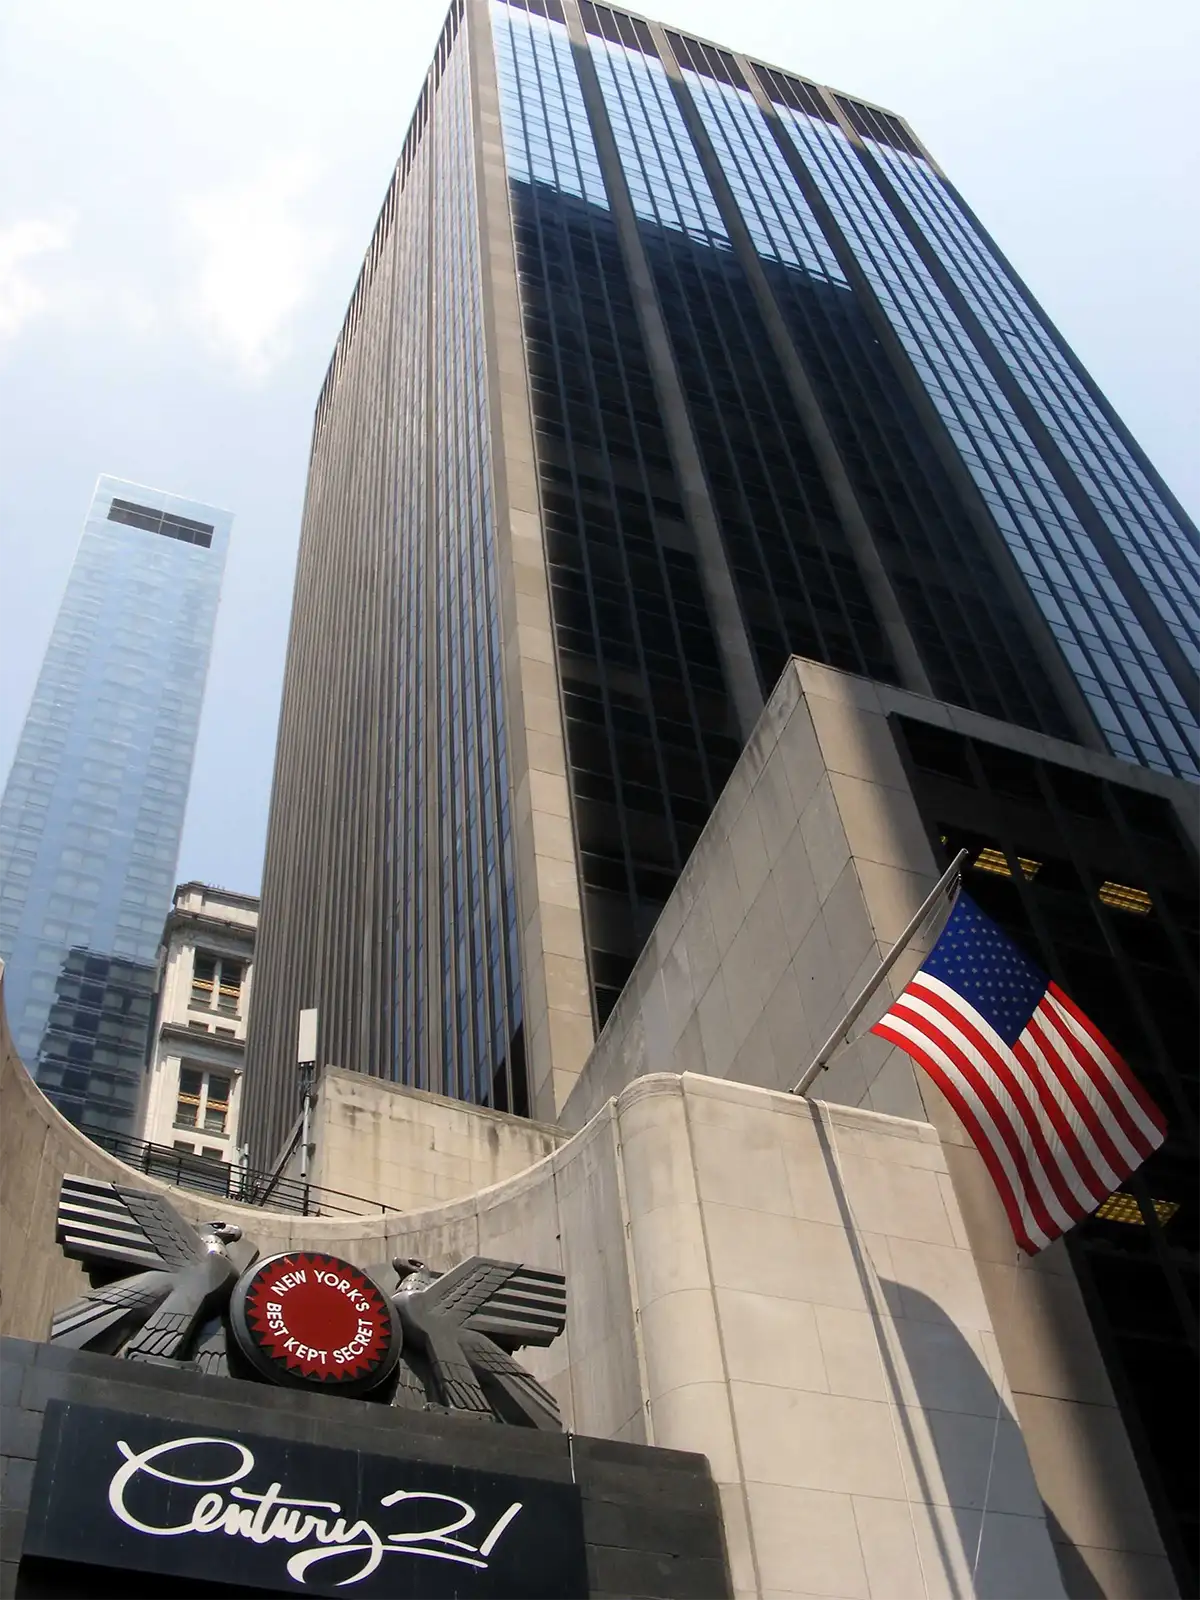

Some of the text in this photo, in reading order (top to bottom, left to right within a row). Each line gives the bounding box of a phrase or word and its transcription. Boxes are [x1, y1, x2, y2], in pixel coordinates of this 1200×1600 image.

[270, 1269, 370, 1312] NEW YORK'S
[266, 1302, 373, 1365] BEST KEPT SECRET
[108, 1436, 523, 1586] Century 21
